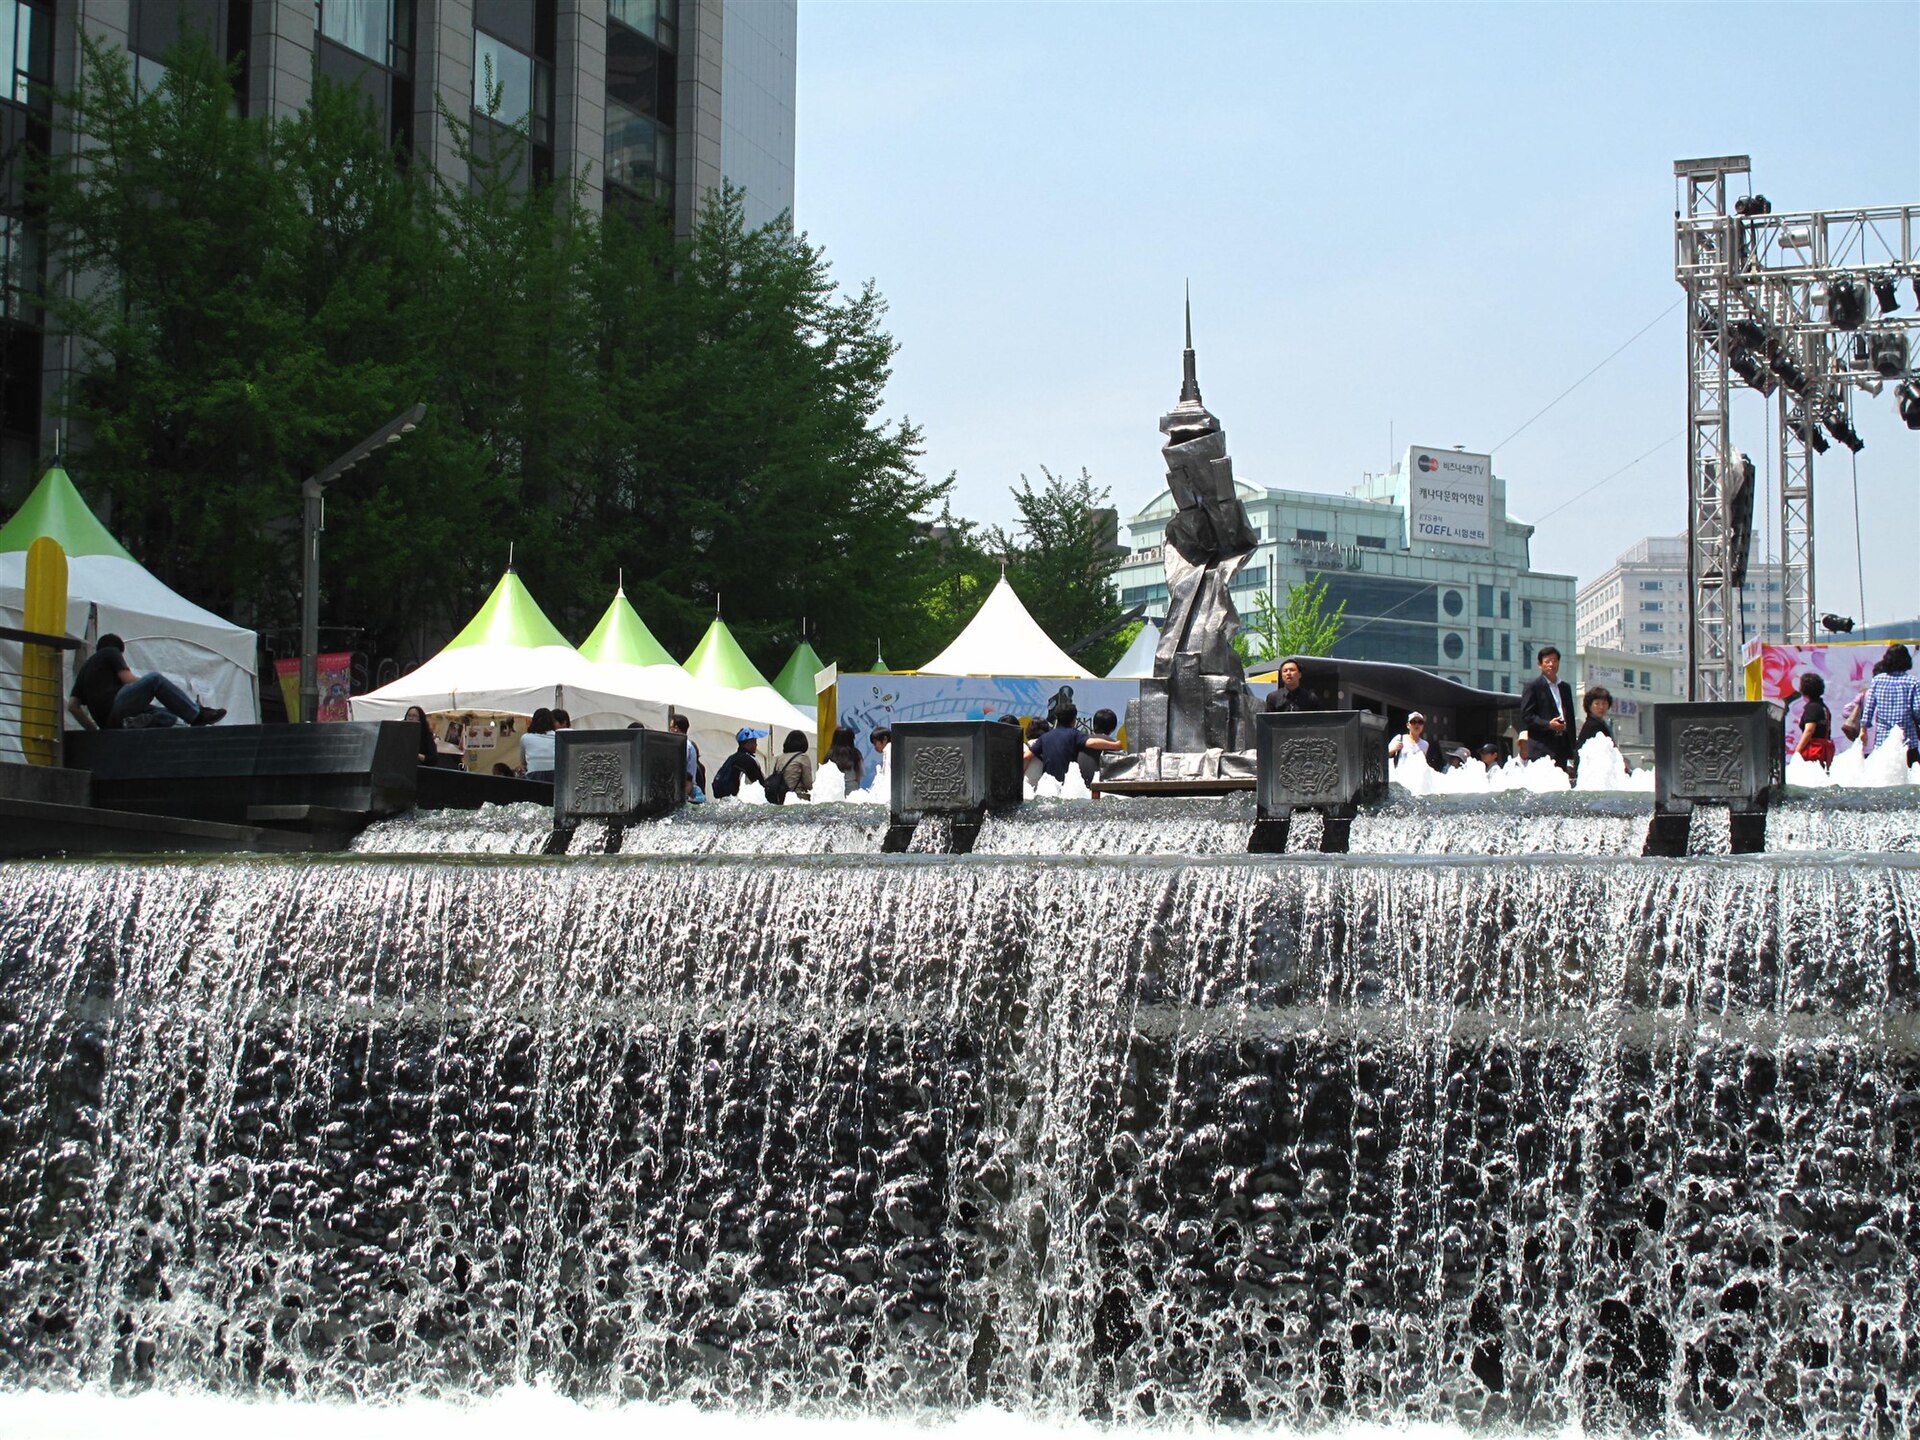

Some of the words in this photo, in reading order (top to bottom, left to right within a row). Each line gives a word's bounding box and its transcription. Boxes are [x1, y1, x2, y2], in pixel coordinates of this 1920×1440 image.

[1419, 488, 1484, 507] 캐나다문화어학원
[1418, 523, 1452, 537] TOEFL
[1454, 529, 1485, 540] 시험센터
